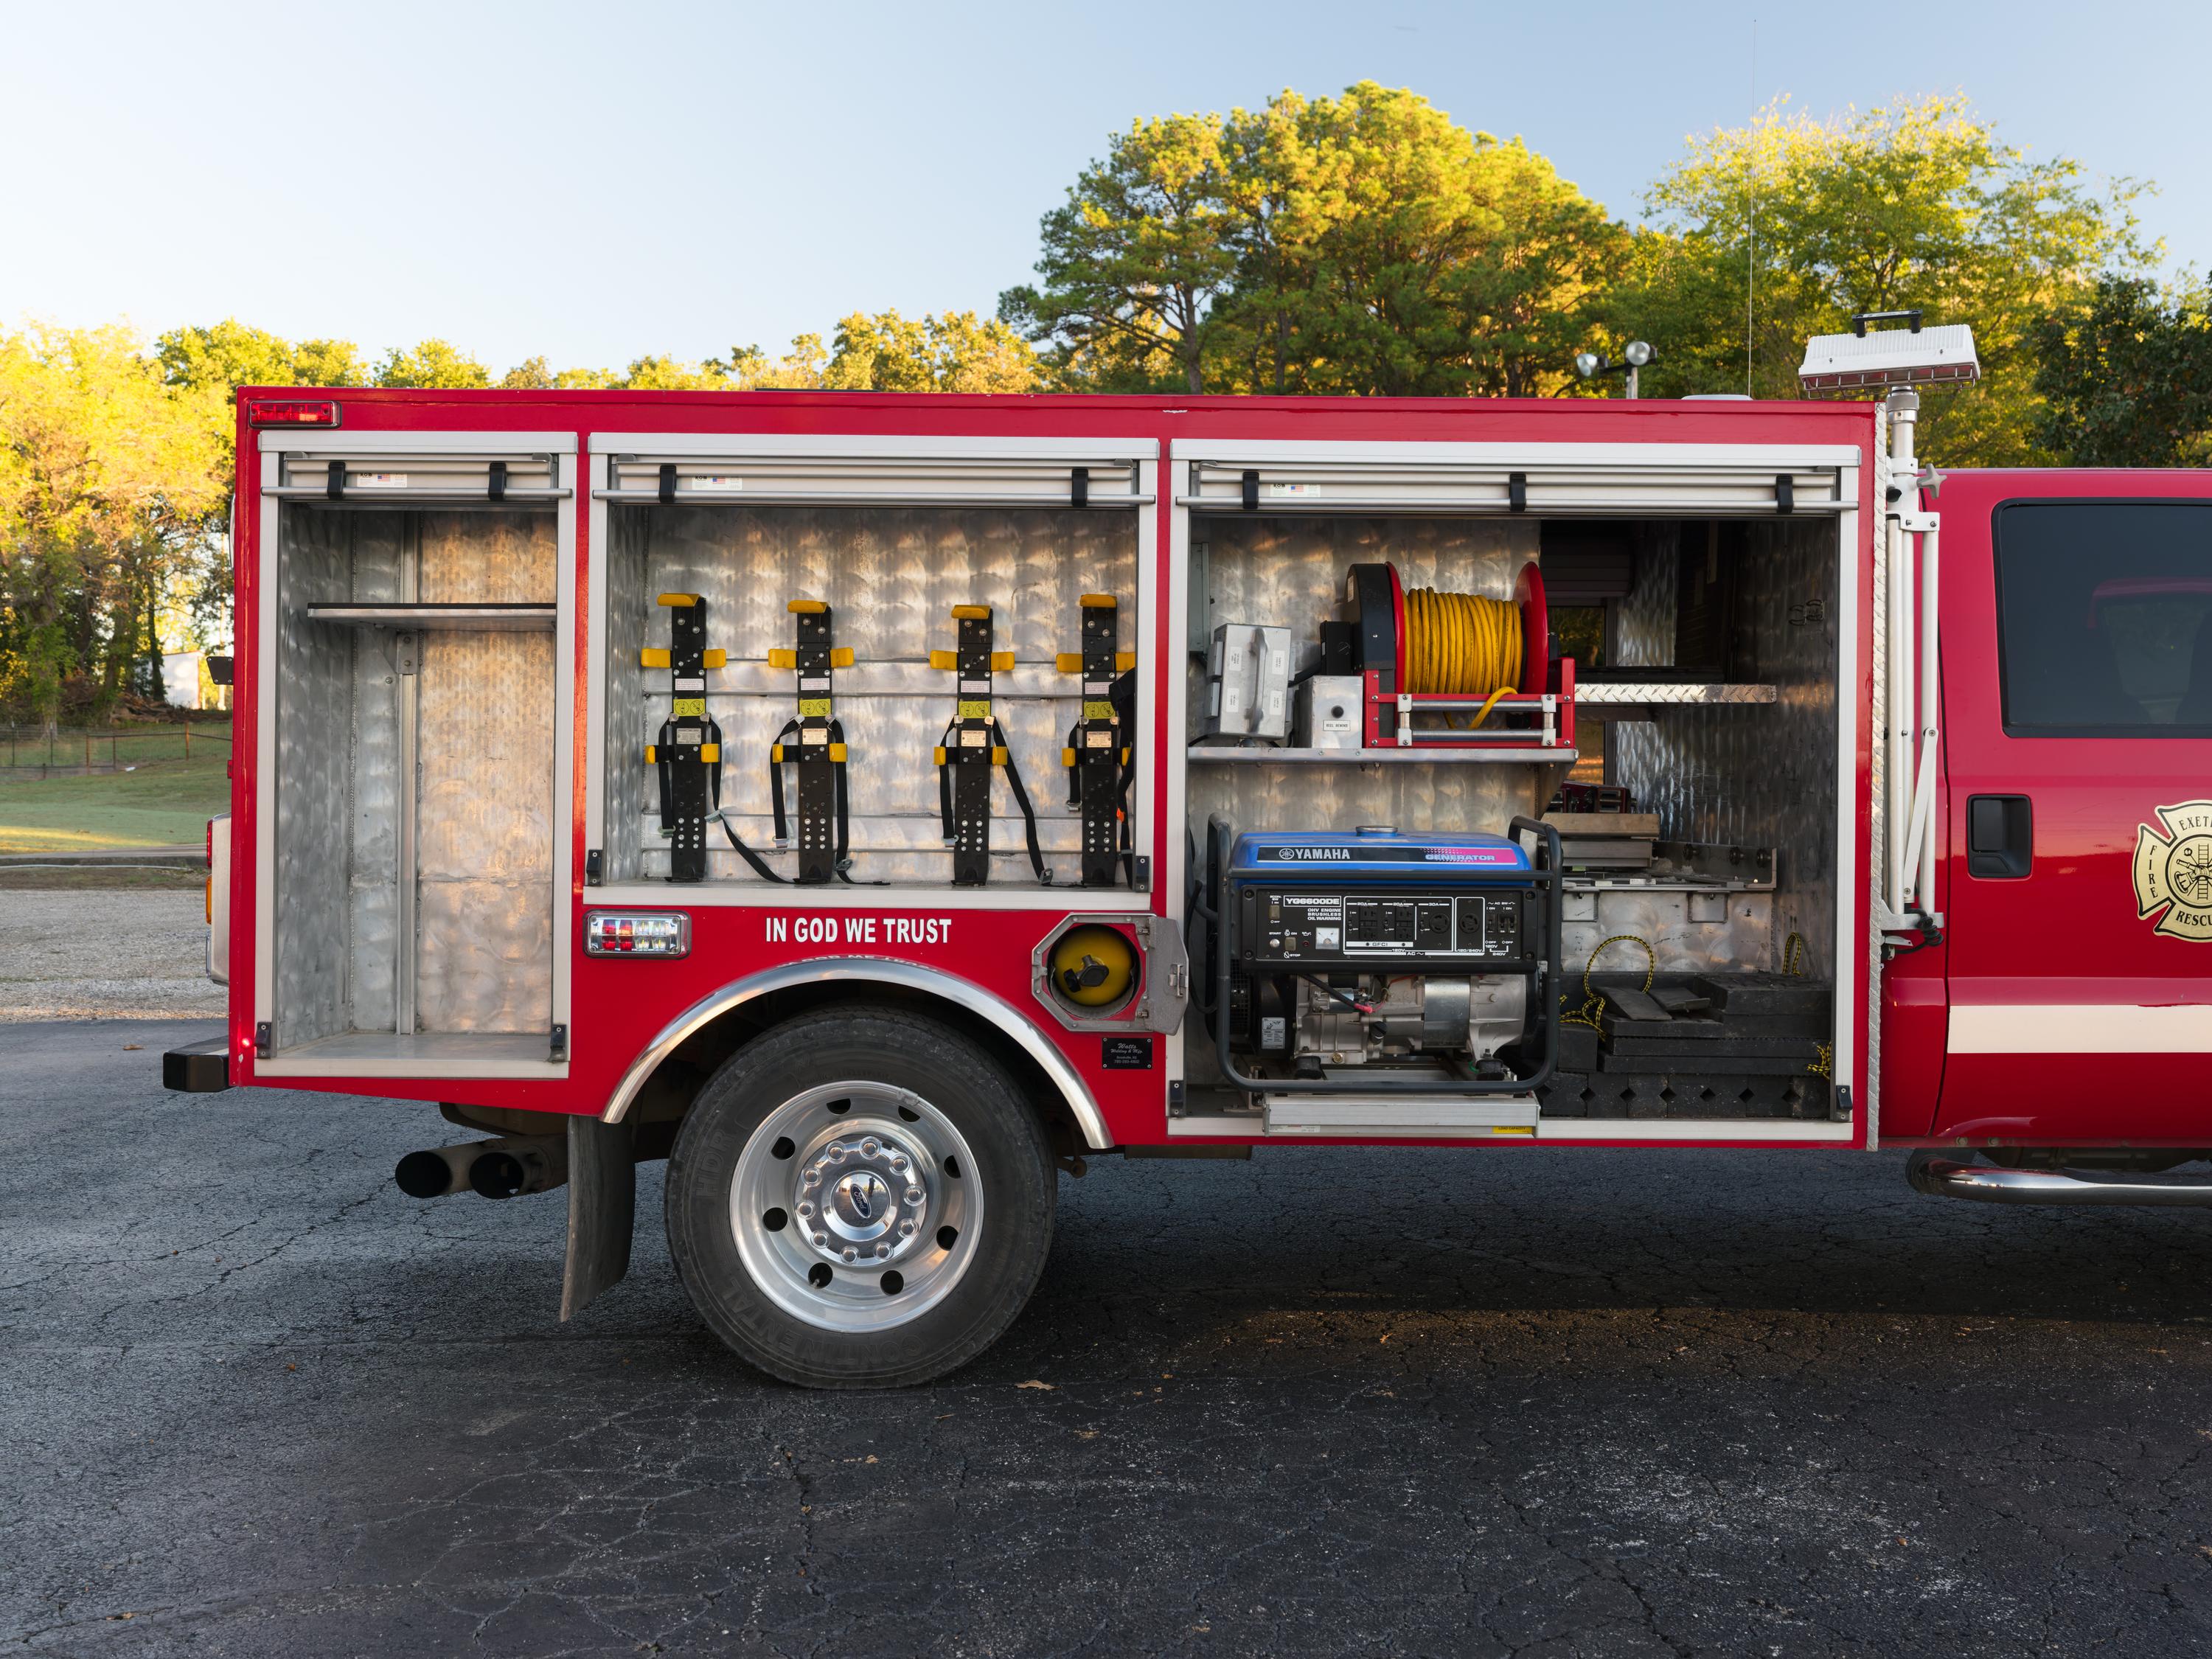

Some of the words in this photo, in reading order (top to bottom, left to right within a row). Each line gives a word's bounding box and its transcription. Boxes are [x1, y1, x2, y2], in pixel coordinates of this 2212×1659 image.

[2178, 815, 2212, 831] EXET
[1295, 848, 1351, 860] YAMAHA
[2148, 844, 2159, 899] FIRE
[765, 917, 787, 942] IN
[793, 917, 838, 943] GOD
[844, 918, 876, 943] WE
[883, 918, 952, 944] TRUST
[695, 1129, 735, 1197] HDR
[721, 1278, 926, 1364] CONTINENTAL
